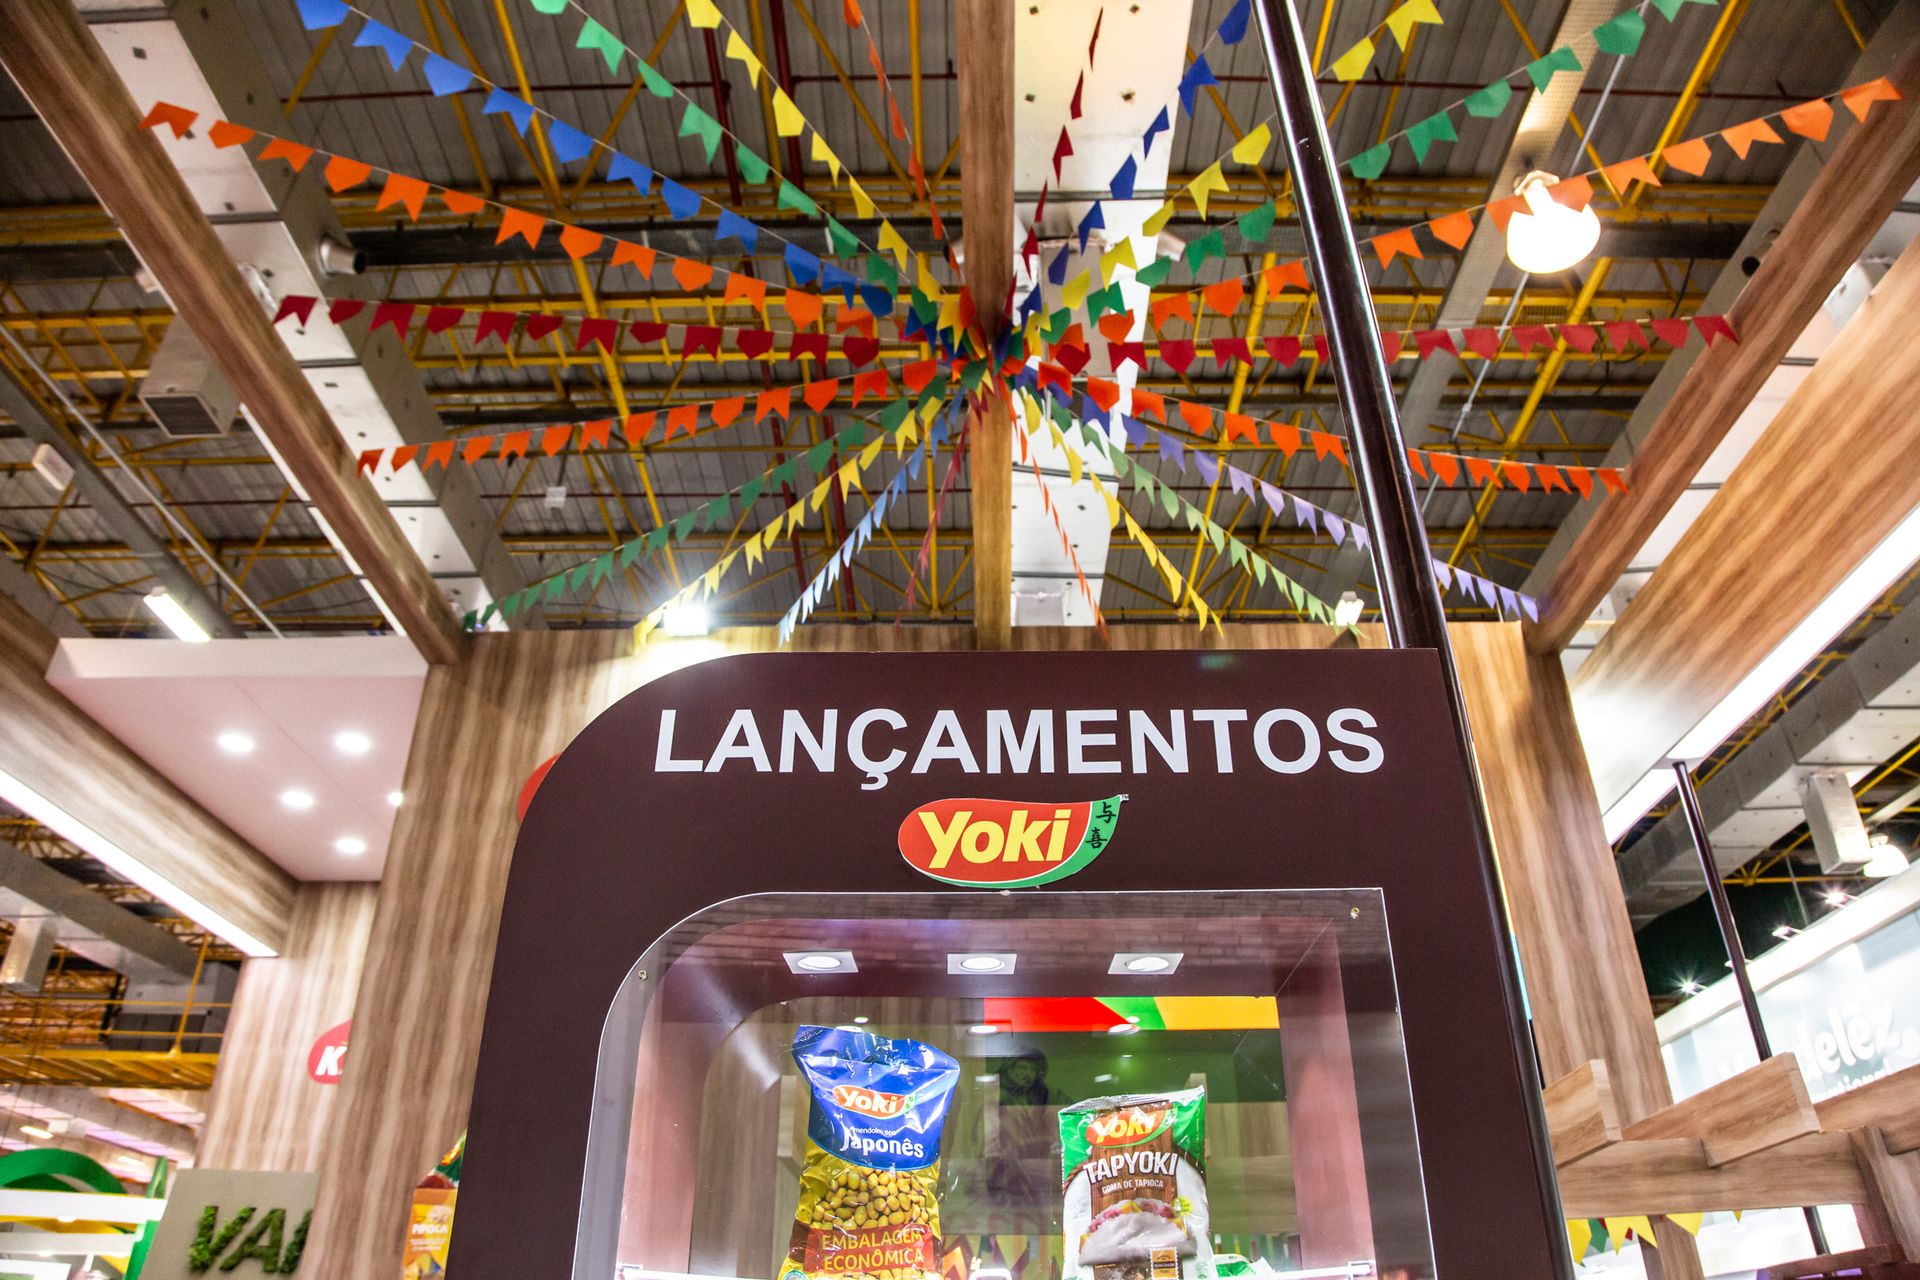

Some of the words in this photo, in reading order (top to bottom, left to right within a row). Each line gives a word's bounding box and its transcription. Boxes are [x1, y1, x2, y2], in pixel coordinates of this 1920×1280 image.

[654, 707, 1385, 791] LANÇAMENTOS
[917, 809, 1072, 869] Yoki
[315, 1045, 348, 1076] K
[837, 1086, 898, 1114] Yoki
[839, 1125, 924, 1158] Japonês
[1083, 1150, 1179, 1184] TAPYOKI
[1101, 1182, 1122, 1194] GOMA
[1123, 1180, 1133, 1188] DE
[1134, 1178, 1164, 1188] TAPIOCA
[821, 1229, 923, 1251] EMBALAGEM
[823, 1248, 925, 1272] ECONÔMICA
